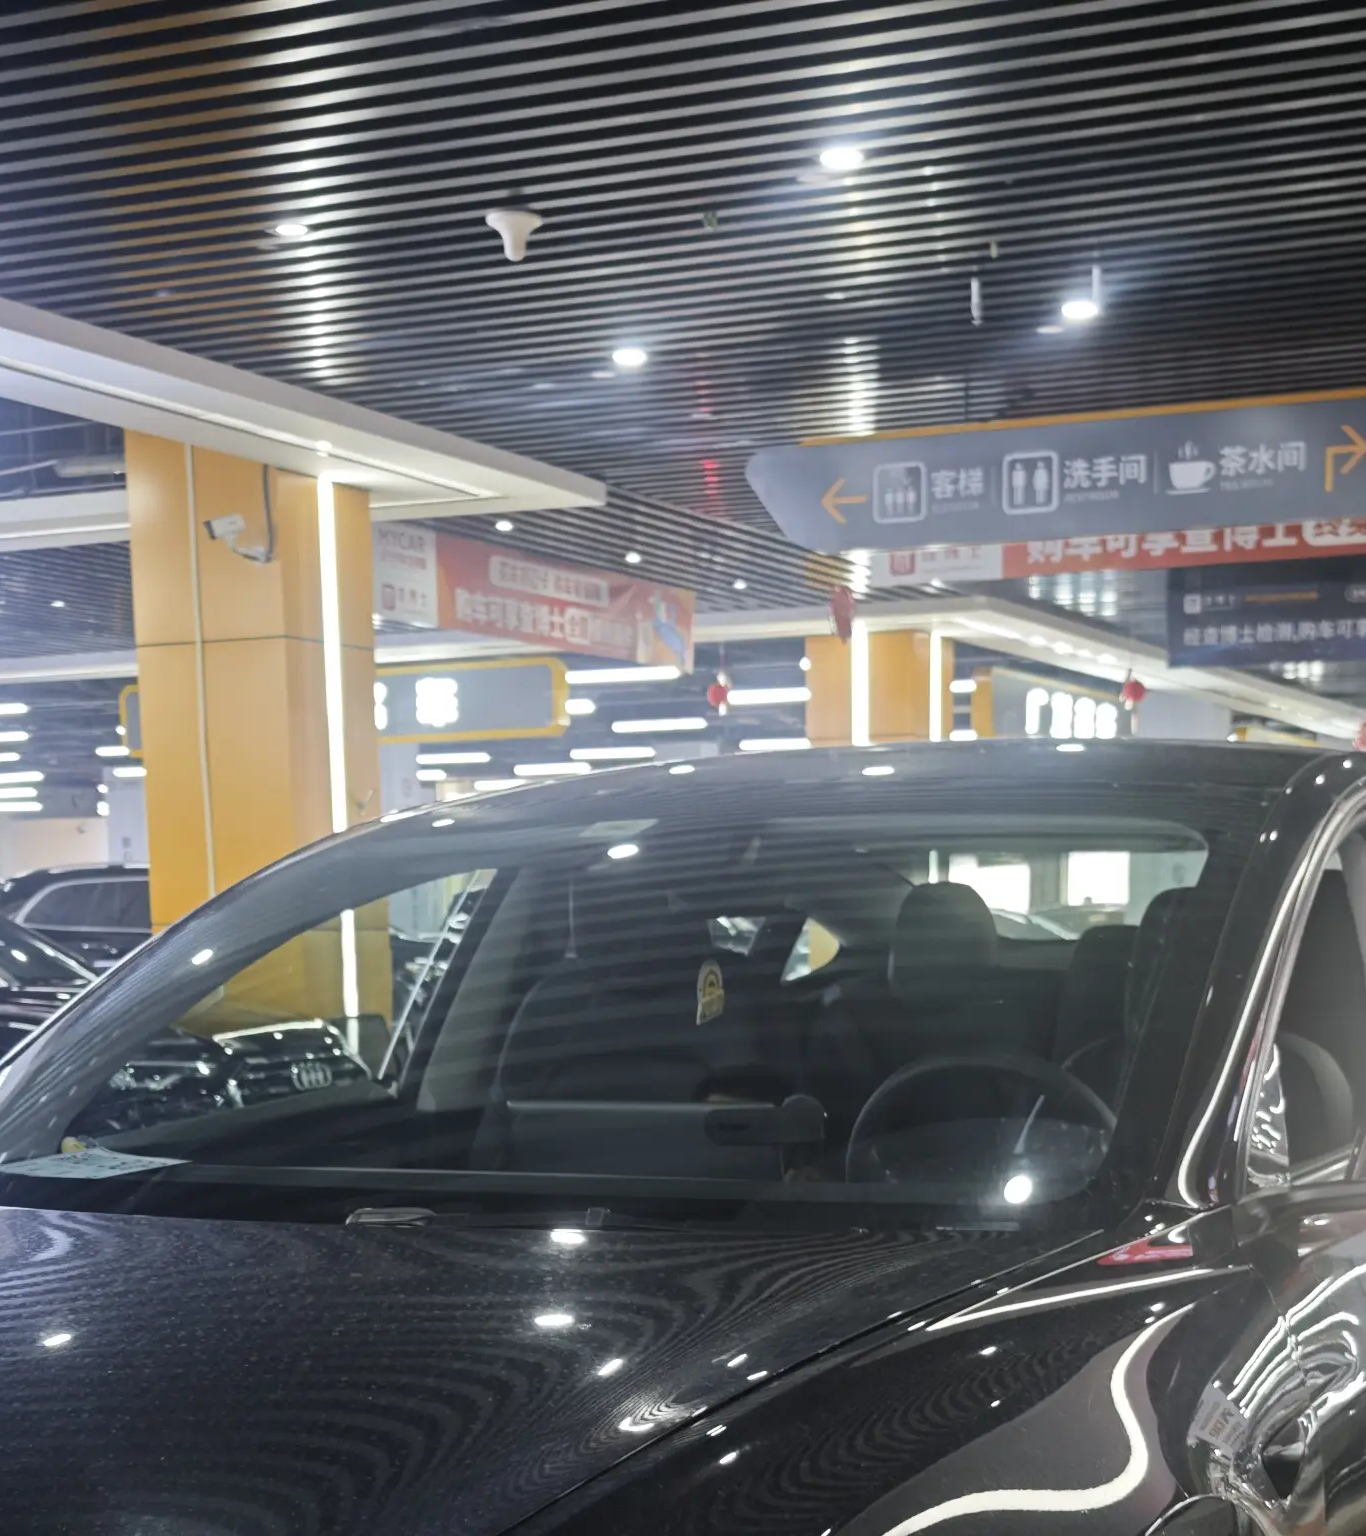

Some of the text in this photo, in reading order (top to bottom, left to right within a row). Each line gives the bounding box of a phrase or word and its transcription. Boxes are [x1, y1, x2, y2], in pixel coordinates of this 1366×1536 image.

[1063, 454, 1147, 490] 洗手间
[1219, 440, 1307, 477] 茶水间
[931, 467, 984, 499] 客梯
